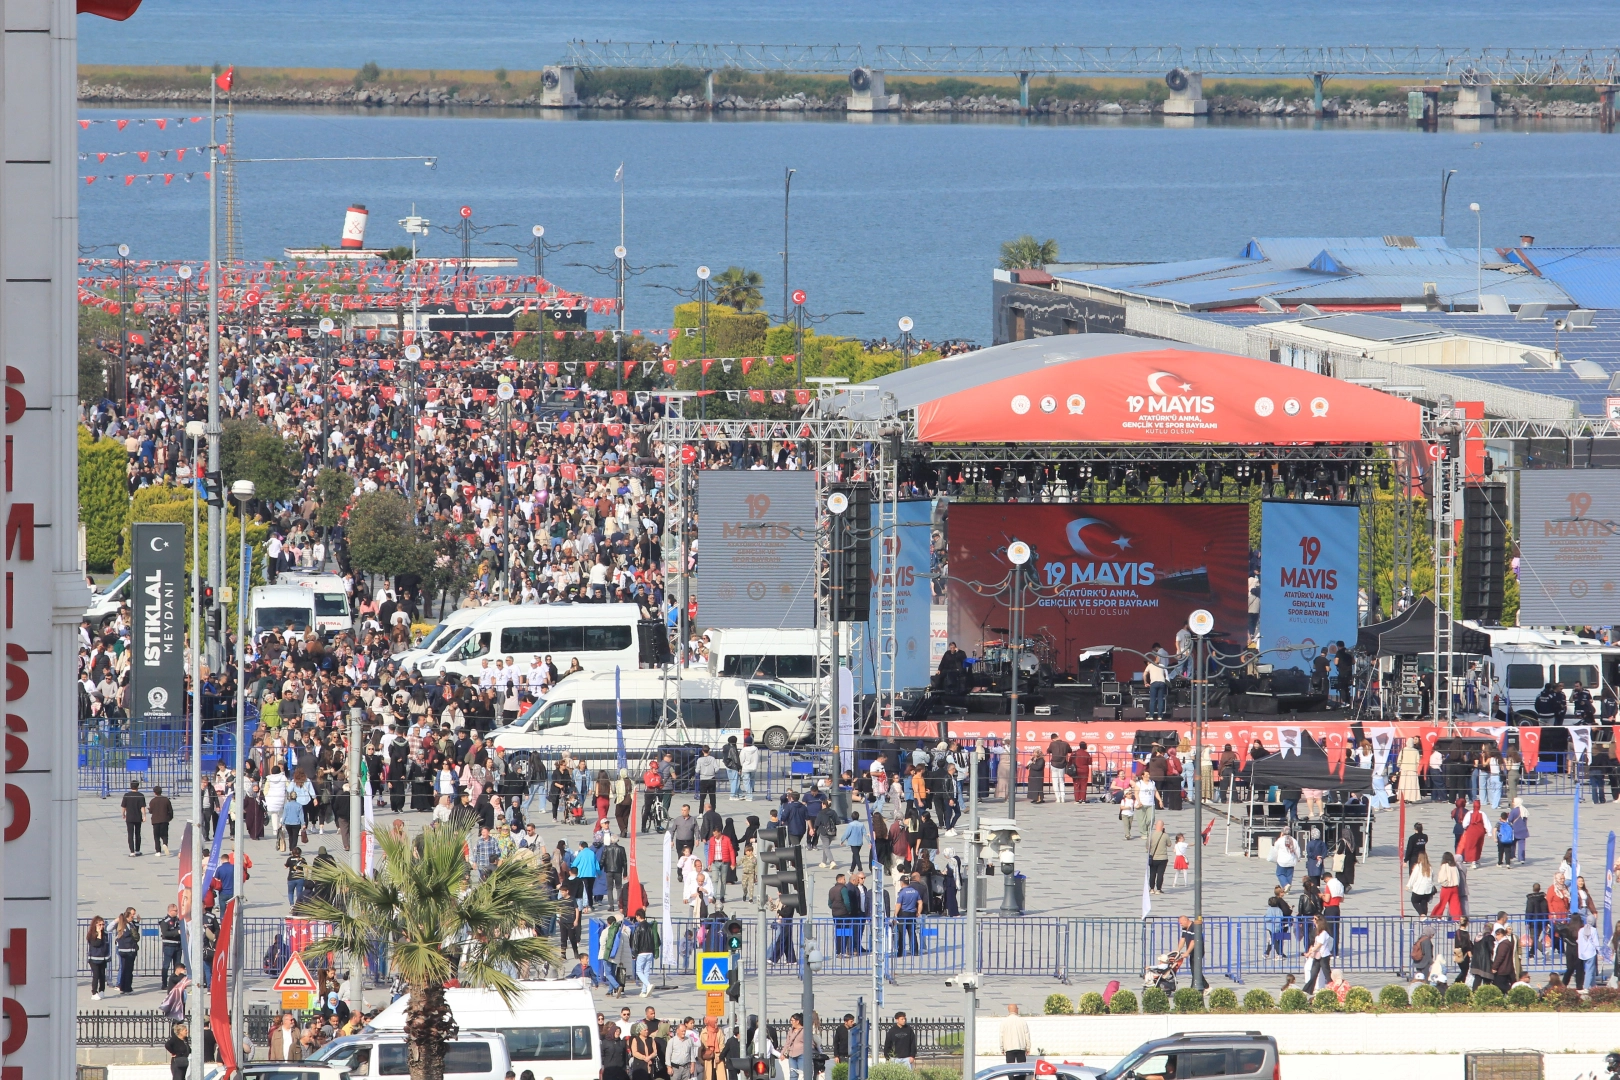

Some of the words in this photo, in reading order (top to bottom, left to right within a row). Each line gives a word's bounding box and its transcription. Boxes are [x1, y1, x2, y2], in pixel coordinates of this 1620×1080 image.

[1126, 396, 1144, 412] 19
[1148, 396, 1215, 413] MAYIS
[1122, 421, 1152, 429] GENÇLİK
[745, 494, 771, 518] 19
[1565, 492, 1592, 517] 19
[722, 522, 791, 539] MAYIS
[1544, 520, 1612, 537] MAYIS
[1299, 536, 1320, 565] 19
[1043, 562, 1066, 585] 19
[1072, 562, 1155, 585] MAYIS
[1281, 567, 1337, 590] MAYIS
[1110, 590, 1138, 598] ANMA,
[1315, 592, 1334, 601] ANMA,
[1039, 598, 1077, 608] GENÇLİK
[1292, 600, 1316, 608] GENÇLİK
[164, 582, 174, 653] MEYDANI
